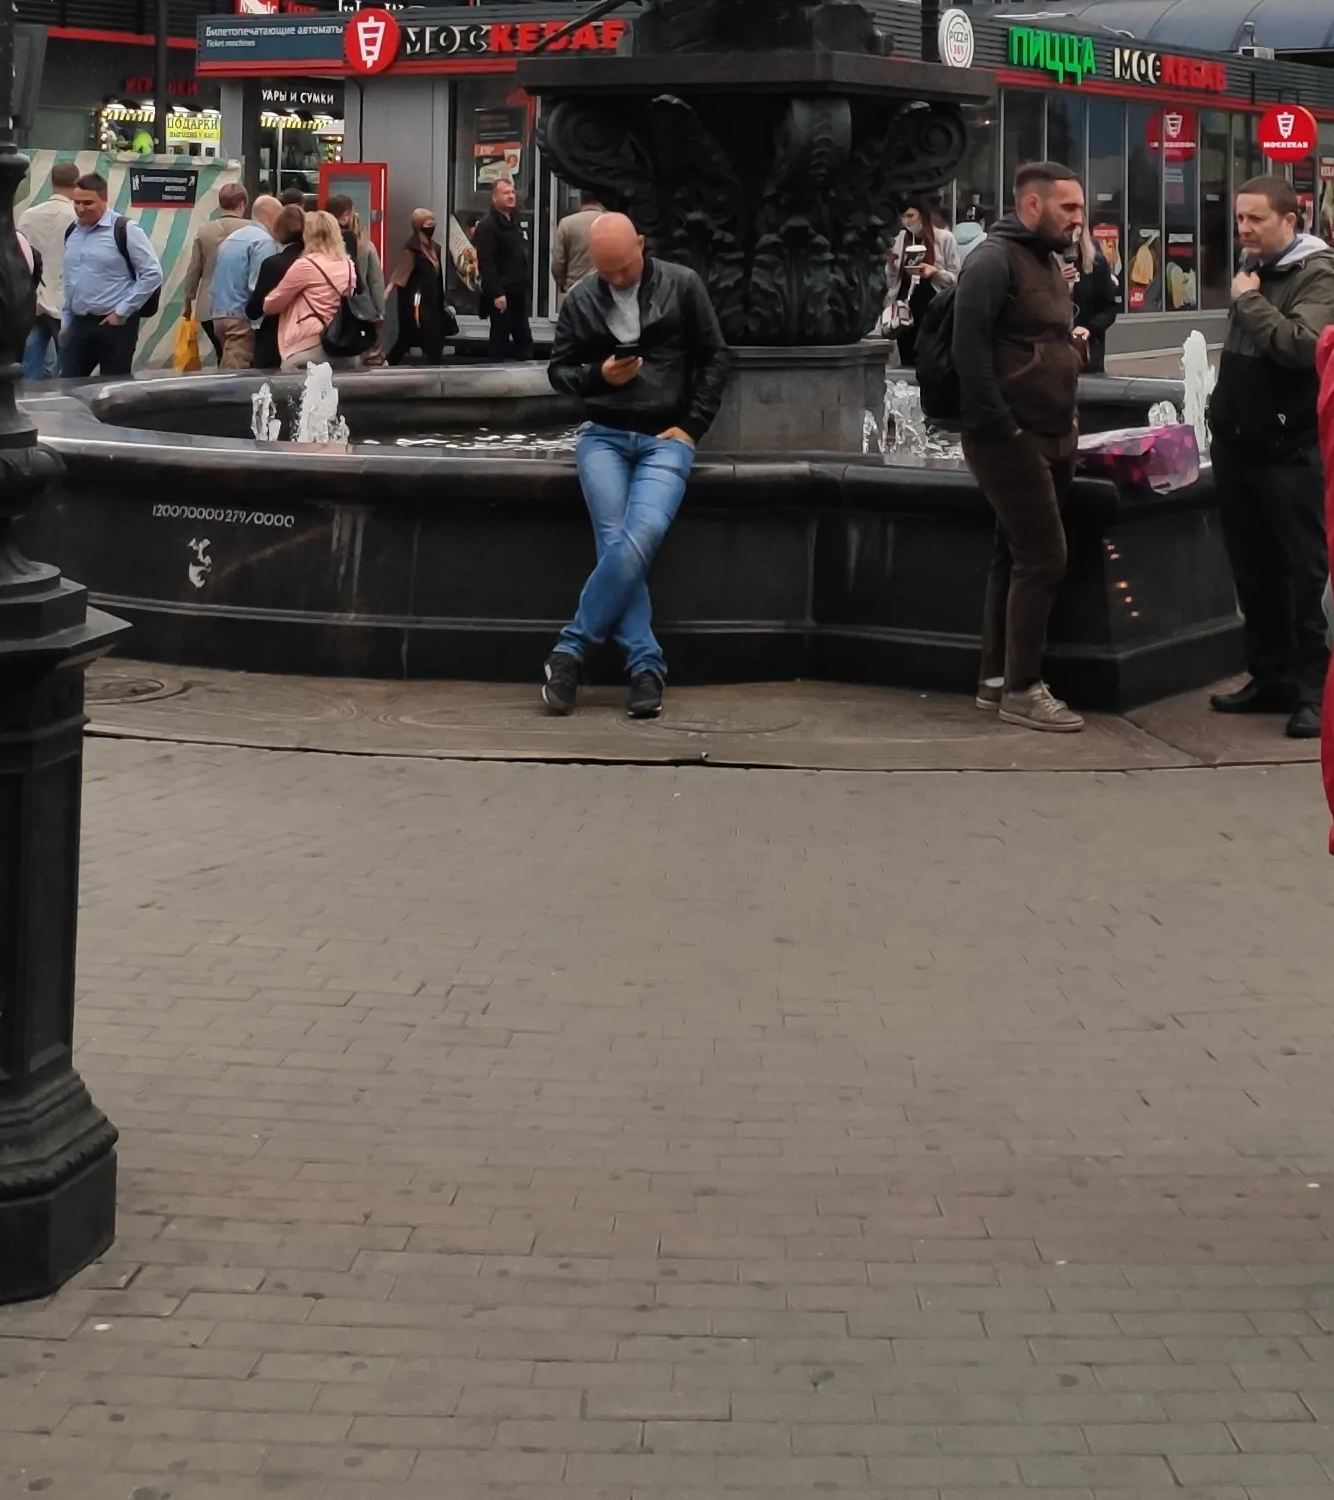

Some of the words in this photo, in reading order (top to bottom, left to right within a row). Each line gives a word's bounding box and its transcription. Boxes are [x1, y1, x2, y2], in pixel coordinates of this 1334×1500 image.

[205, 26, 296, 37] Билетопечатающие
[297, 25, 344, 35] автоматы
[1008, 25, 1097, 85] ПИЦЦА
[1114, 47, 1227, 92] МОСКЕБАБ
[261, 89, 286, 102] УАРЫ
[290, 91, 297, 102] И
[300, 92, 334, 105] СУМКИ
